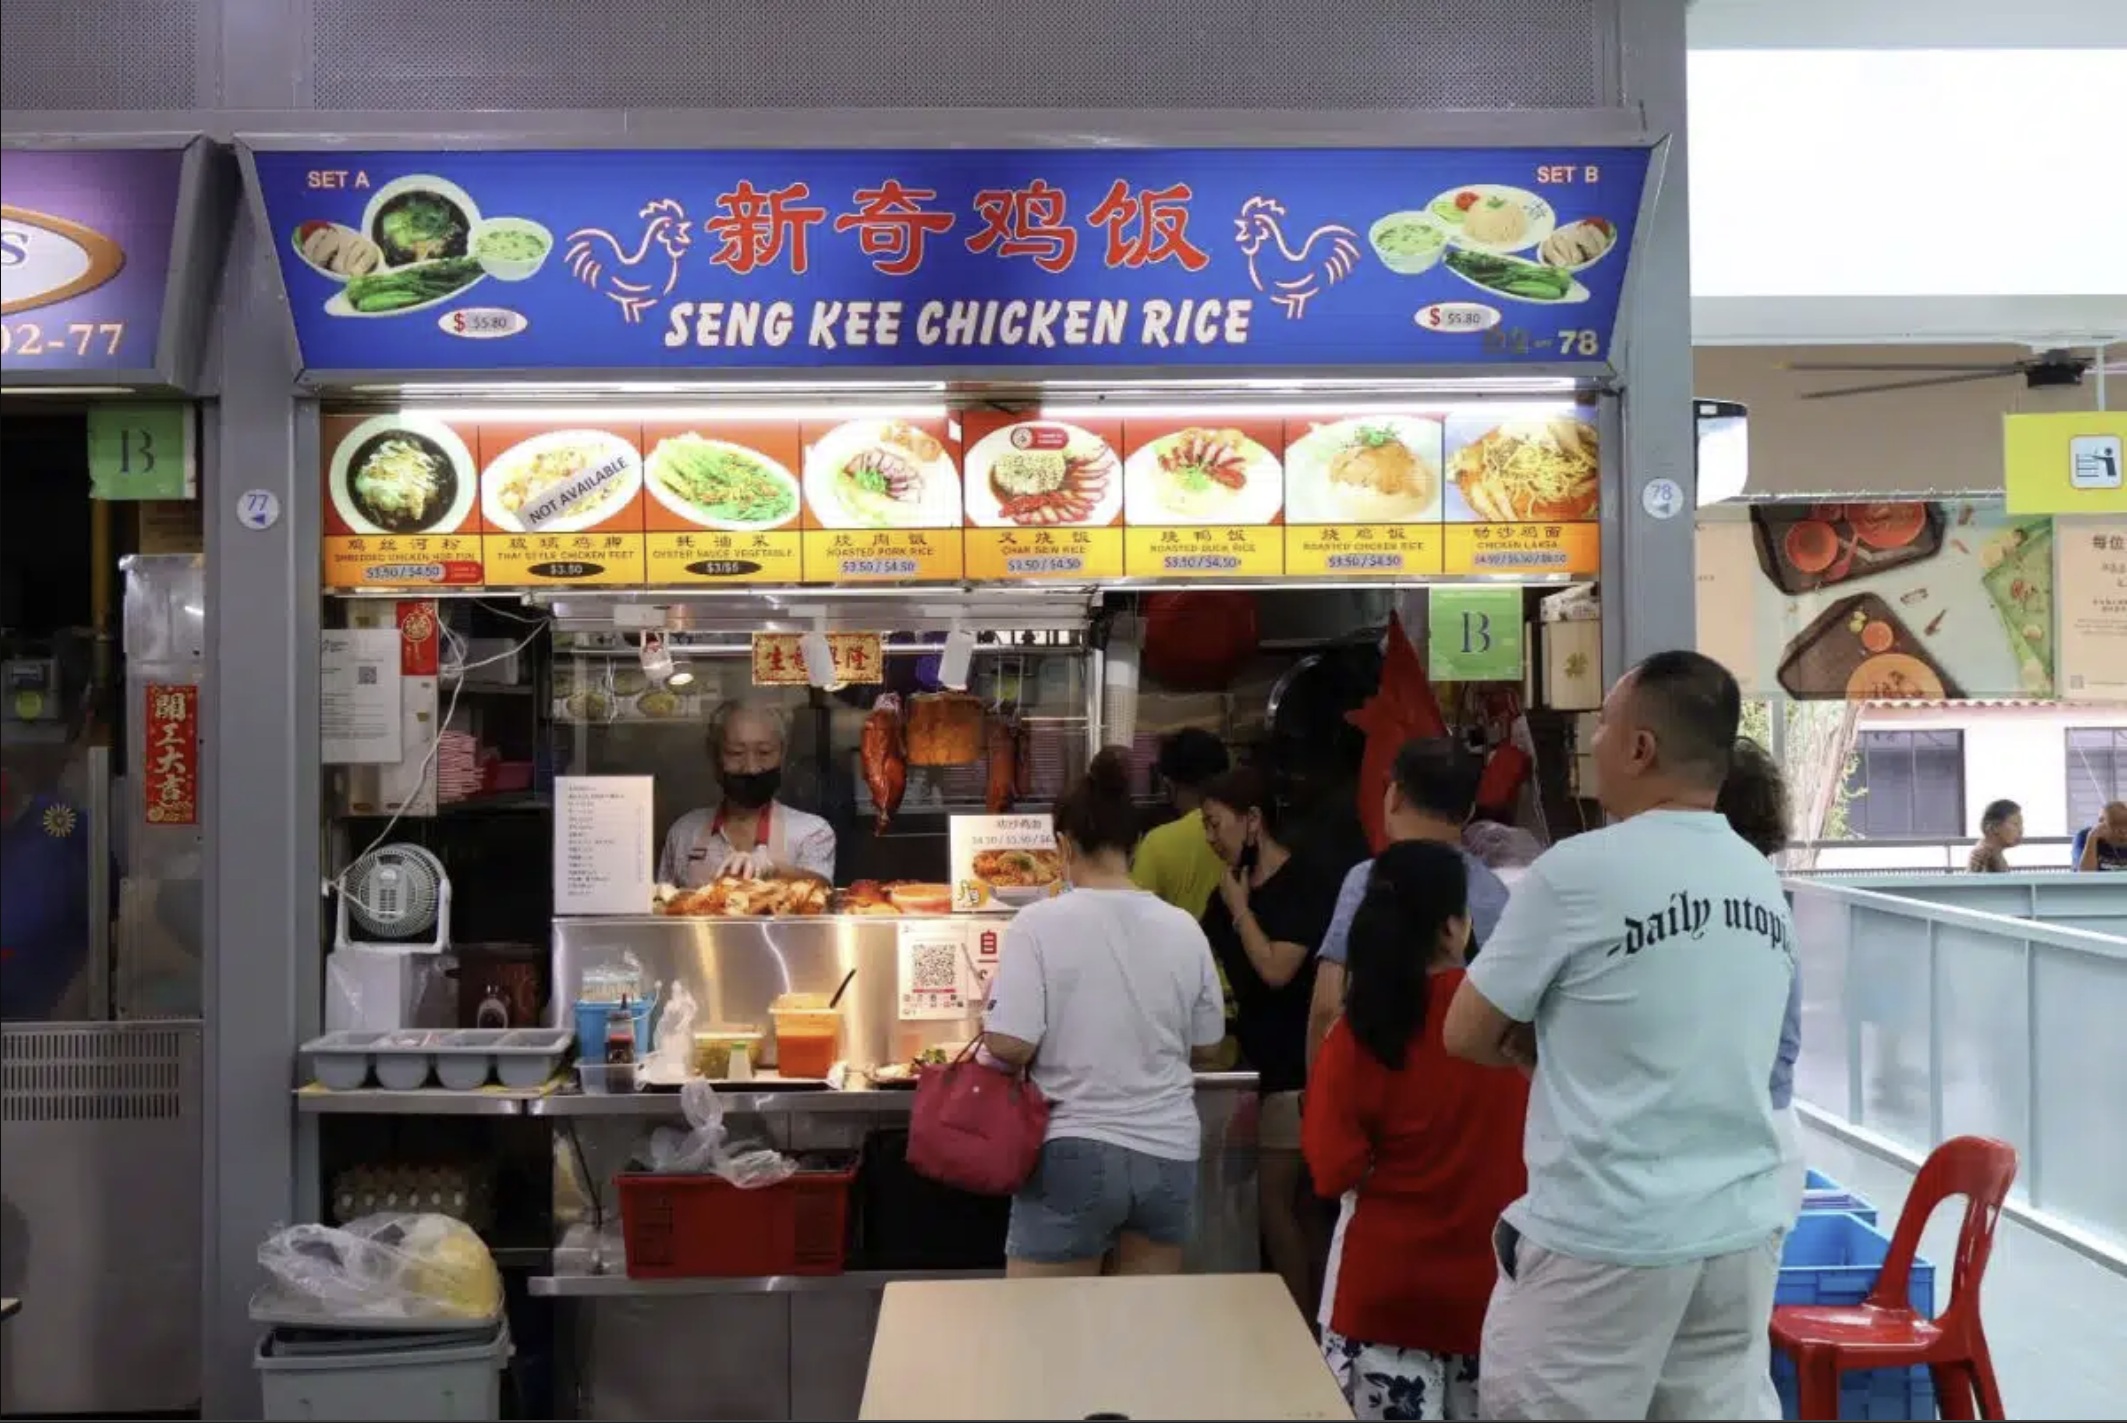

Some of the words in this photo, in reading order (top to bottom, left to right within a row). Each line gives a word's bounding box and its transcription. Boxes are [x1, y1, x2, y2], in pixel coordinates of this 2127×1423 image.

[308, 171, 348, 188] SET
[355, 171, 370, 188] A
[1537, 166, 1576, 184] SET
[1585, 166, 1599, 184] B
[705, 179, 1210, 275] 新奇鸡饭
[664, 300, 794, 349] SENG
[808, 300, 902, 351] KEE
[917, 299, 1129, 349] CHICKEN
[1141, 298, 1253, 349] RICE
[120, 429, 156, 473] B
[529, 499, 559, 524] NOT
[560, 456, 629, 507] AVAILABLE
[1651, 484, 1673, 500] 78
[247, 494, 269, 511] 77
[997, 532, 1092, 544] 叉烧饭
[1160, 530, 1247, 543] 烧鸭饭
[825, 548, 875, 558] ROASTED
[877, 547, 907, 557] PORK
[909, 547, 934, 556] RICE
[999, 546, 1031, 555] CHAR
[1062, 545, 1087, 554] RICE
[1149, 545, 1198, 553] ROASTED
[1201, 544, 1230, 553] DUCK
[1232, 544, 1256, 553] RICE
[1303, 541, 1351, 551] ROASTED
[1353, 541, 1398, 551] CHICKEN
[1476, 541, 1522, 550] CHICKEN
[1524, 541, 1558, 550] LAKSA
[498, 552, 521, 561] THAI
[524, 552, 557, 561] STYLE
[560, 551, 606, 560] CHICKEN
[608, 550, 636, 560] FEET
[652, 550, 693, 559] OYSTER
[1460, 611, 1492, 654] B
[763, 645, 869, 673] 生意隆
[154, 692, 187, 808] 開工大吉
